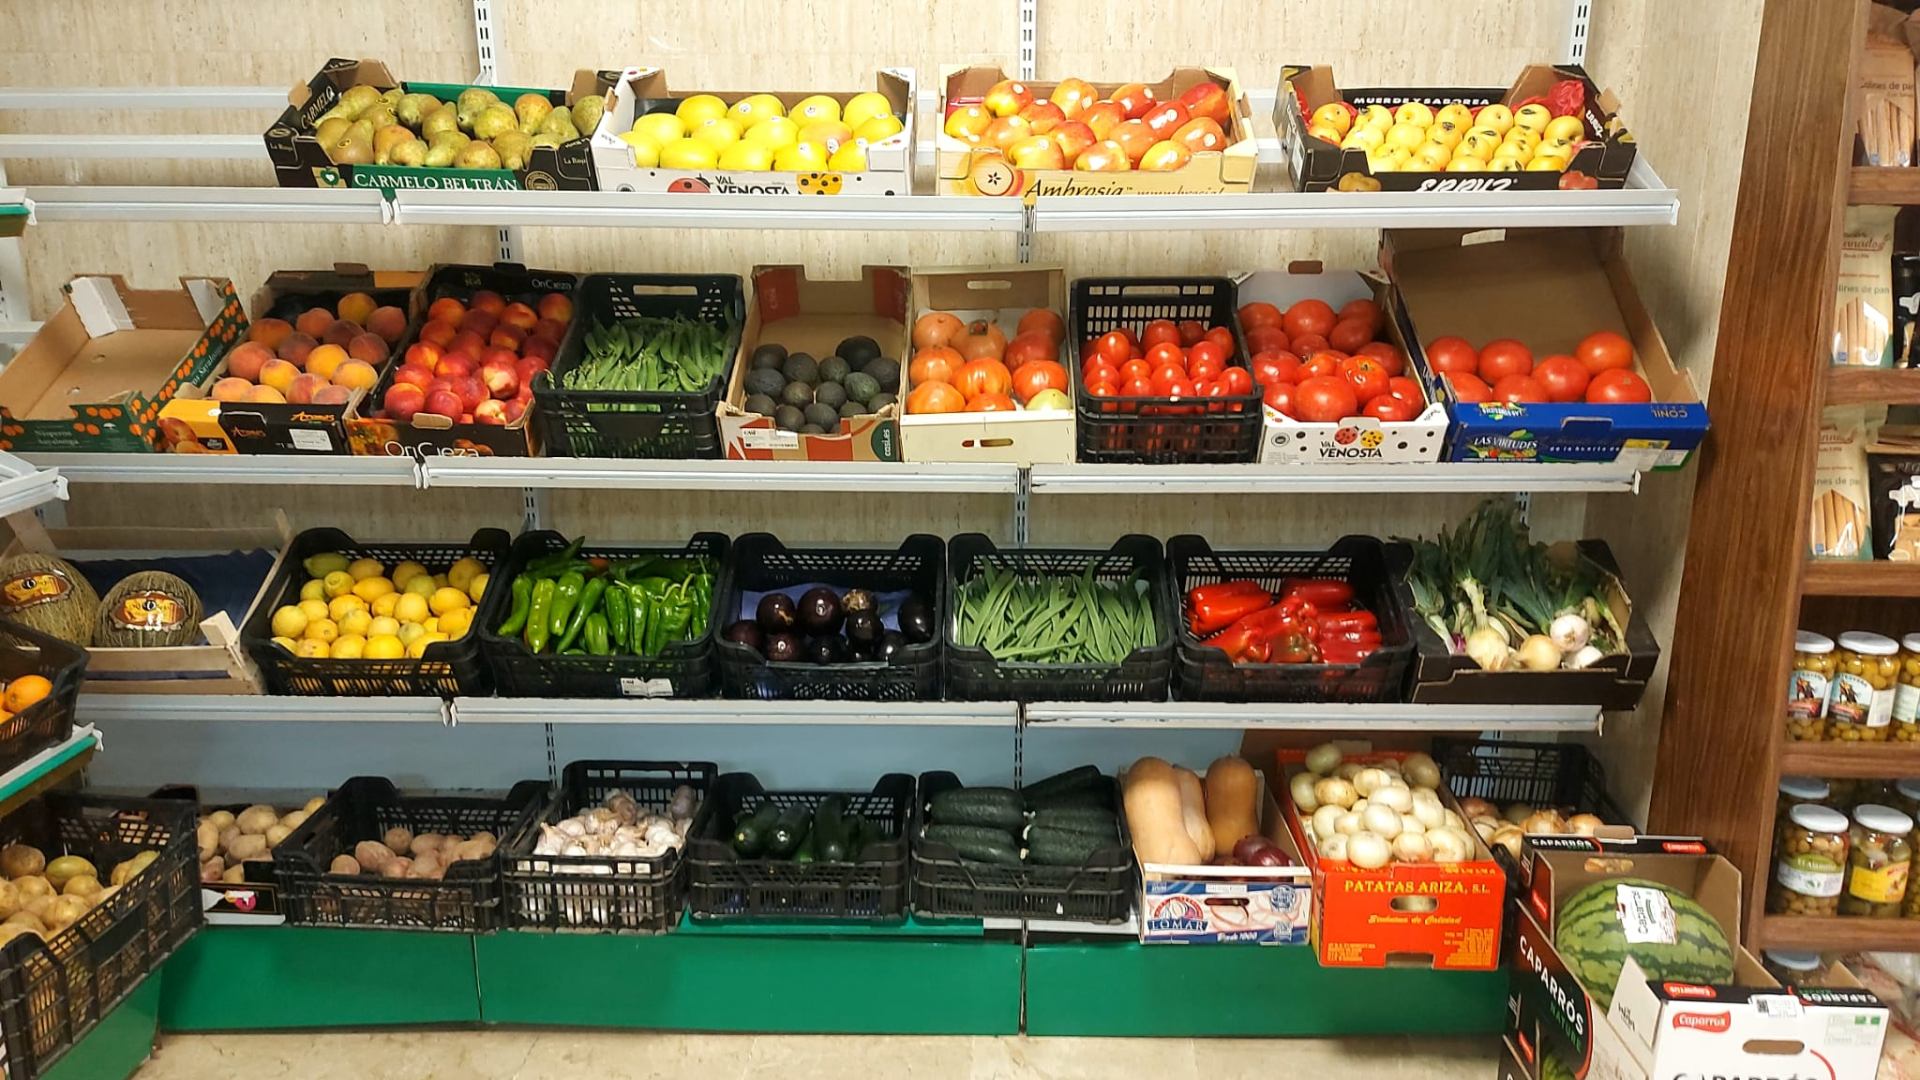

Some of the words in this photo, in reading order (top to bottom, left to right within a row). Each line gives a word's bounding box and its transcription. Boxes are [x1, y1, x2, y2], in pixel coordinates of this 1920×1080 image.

[353, 173, 439, 190] CARMELO
[443, 175, 518, 192] BELTRÁN
[715, 175, 734, 185] VAL
[717, 185, 790, 195] VENOSTA
[385, 440, 480, 459] OnCieza
[1473, 436, 1491, 445] LAS
[1492, 437, 1539, 450] VIRTUDES
[1319, 447, 1383, 458] VENOSTA
[1345, 879, 1415, 893] PATATAS
[1418, 881, 1468, 894] ARIZA,
[1151, 920, 1205, 932] LOMAR
[1519, 935, 1584, 1036] CAPARRÓS
[1550, 1001, 1582, 1054] NATURE
